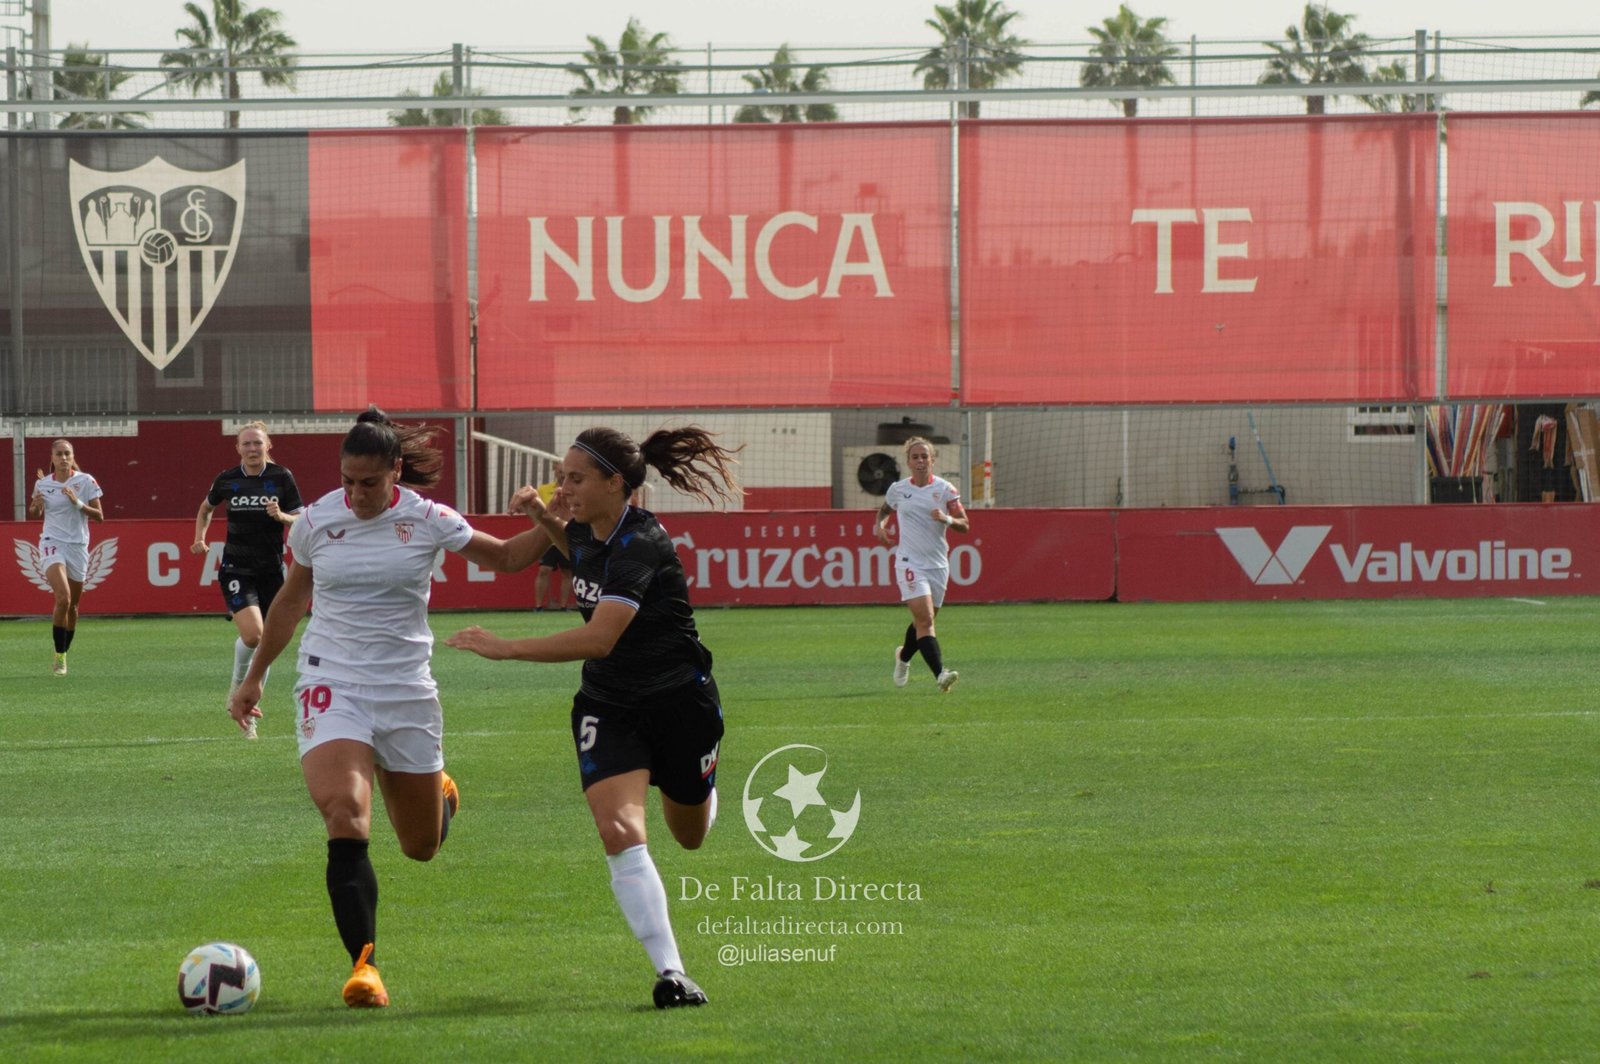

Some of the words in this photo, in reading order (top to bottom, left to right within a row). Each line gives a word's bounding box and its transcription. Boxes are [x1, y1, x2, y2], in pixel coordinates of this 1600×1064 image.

[527, 211, 895, 303] NUNCA
[1131, 208, 1258, 293] TE
[1492, 201, 1600, 288] RI
[744, 525, 817, 538] DESDE
[905, 567, 915, 582] 6
[1329, 540, 1572, 583] Valvoline
[228, 579, 241, 595] 9
[300, 685, 332, 719] 19
[580, 715, 600, 752] 5
